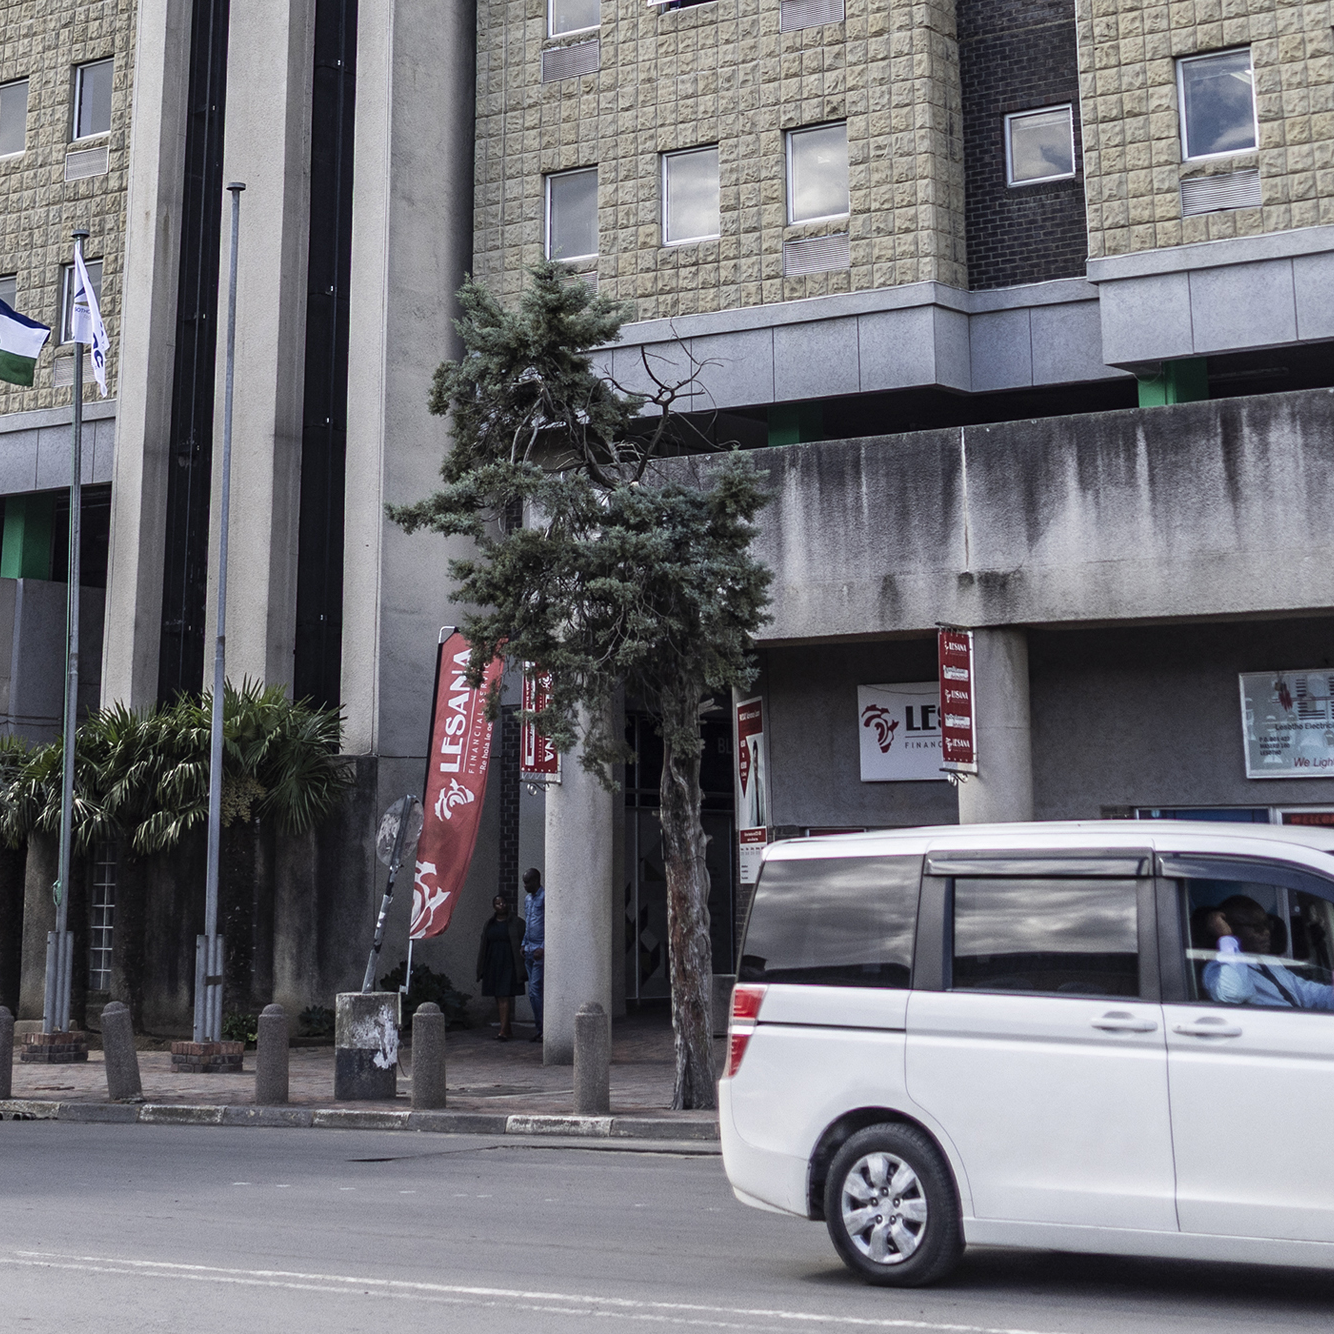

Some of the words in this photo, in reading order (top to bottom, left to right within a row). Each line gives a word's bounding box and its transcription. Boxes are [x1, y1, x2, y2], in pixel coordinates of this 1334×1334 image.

[440, 648, 473, 773] LESANA
[1275, 722, 1304, 731] Lesotho
[468, 711, 484, 774] FINANCIAL
[905, 741, 942, 749] FINANC
[1294, 757, 1310, 767] We
